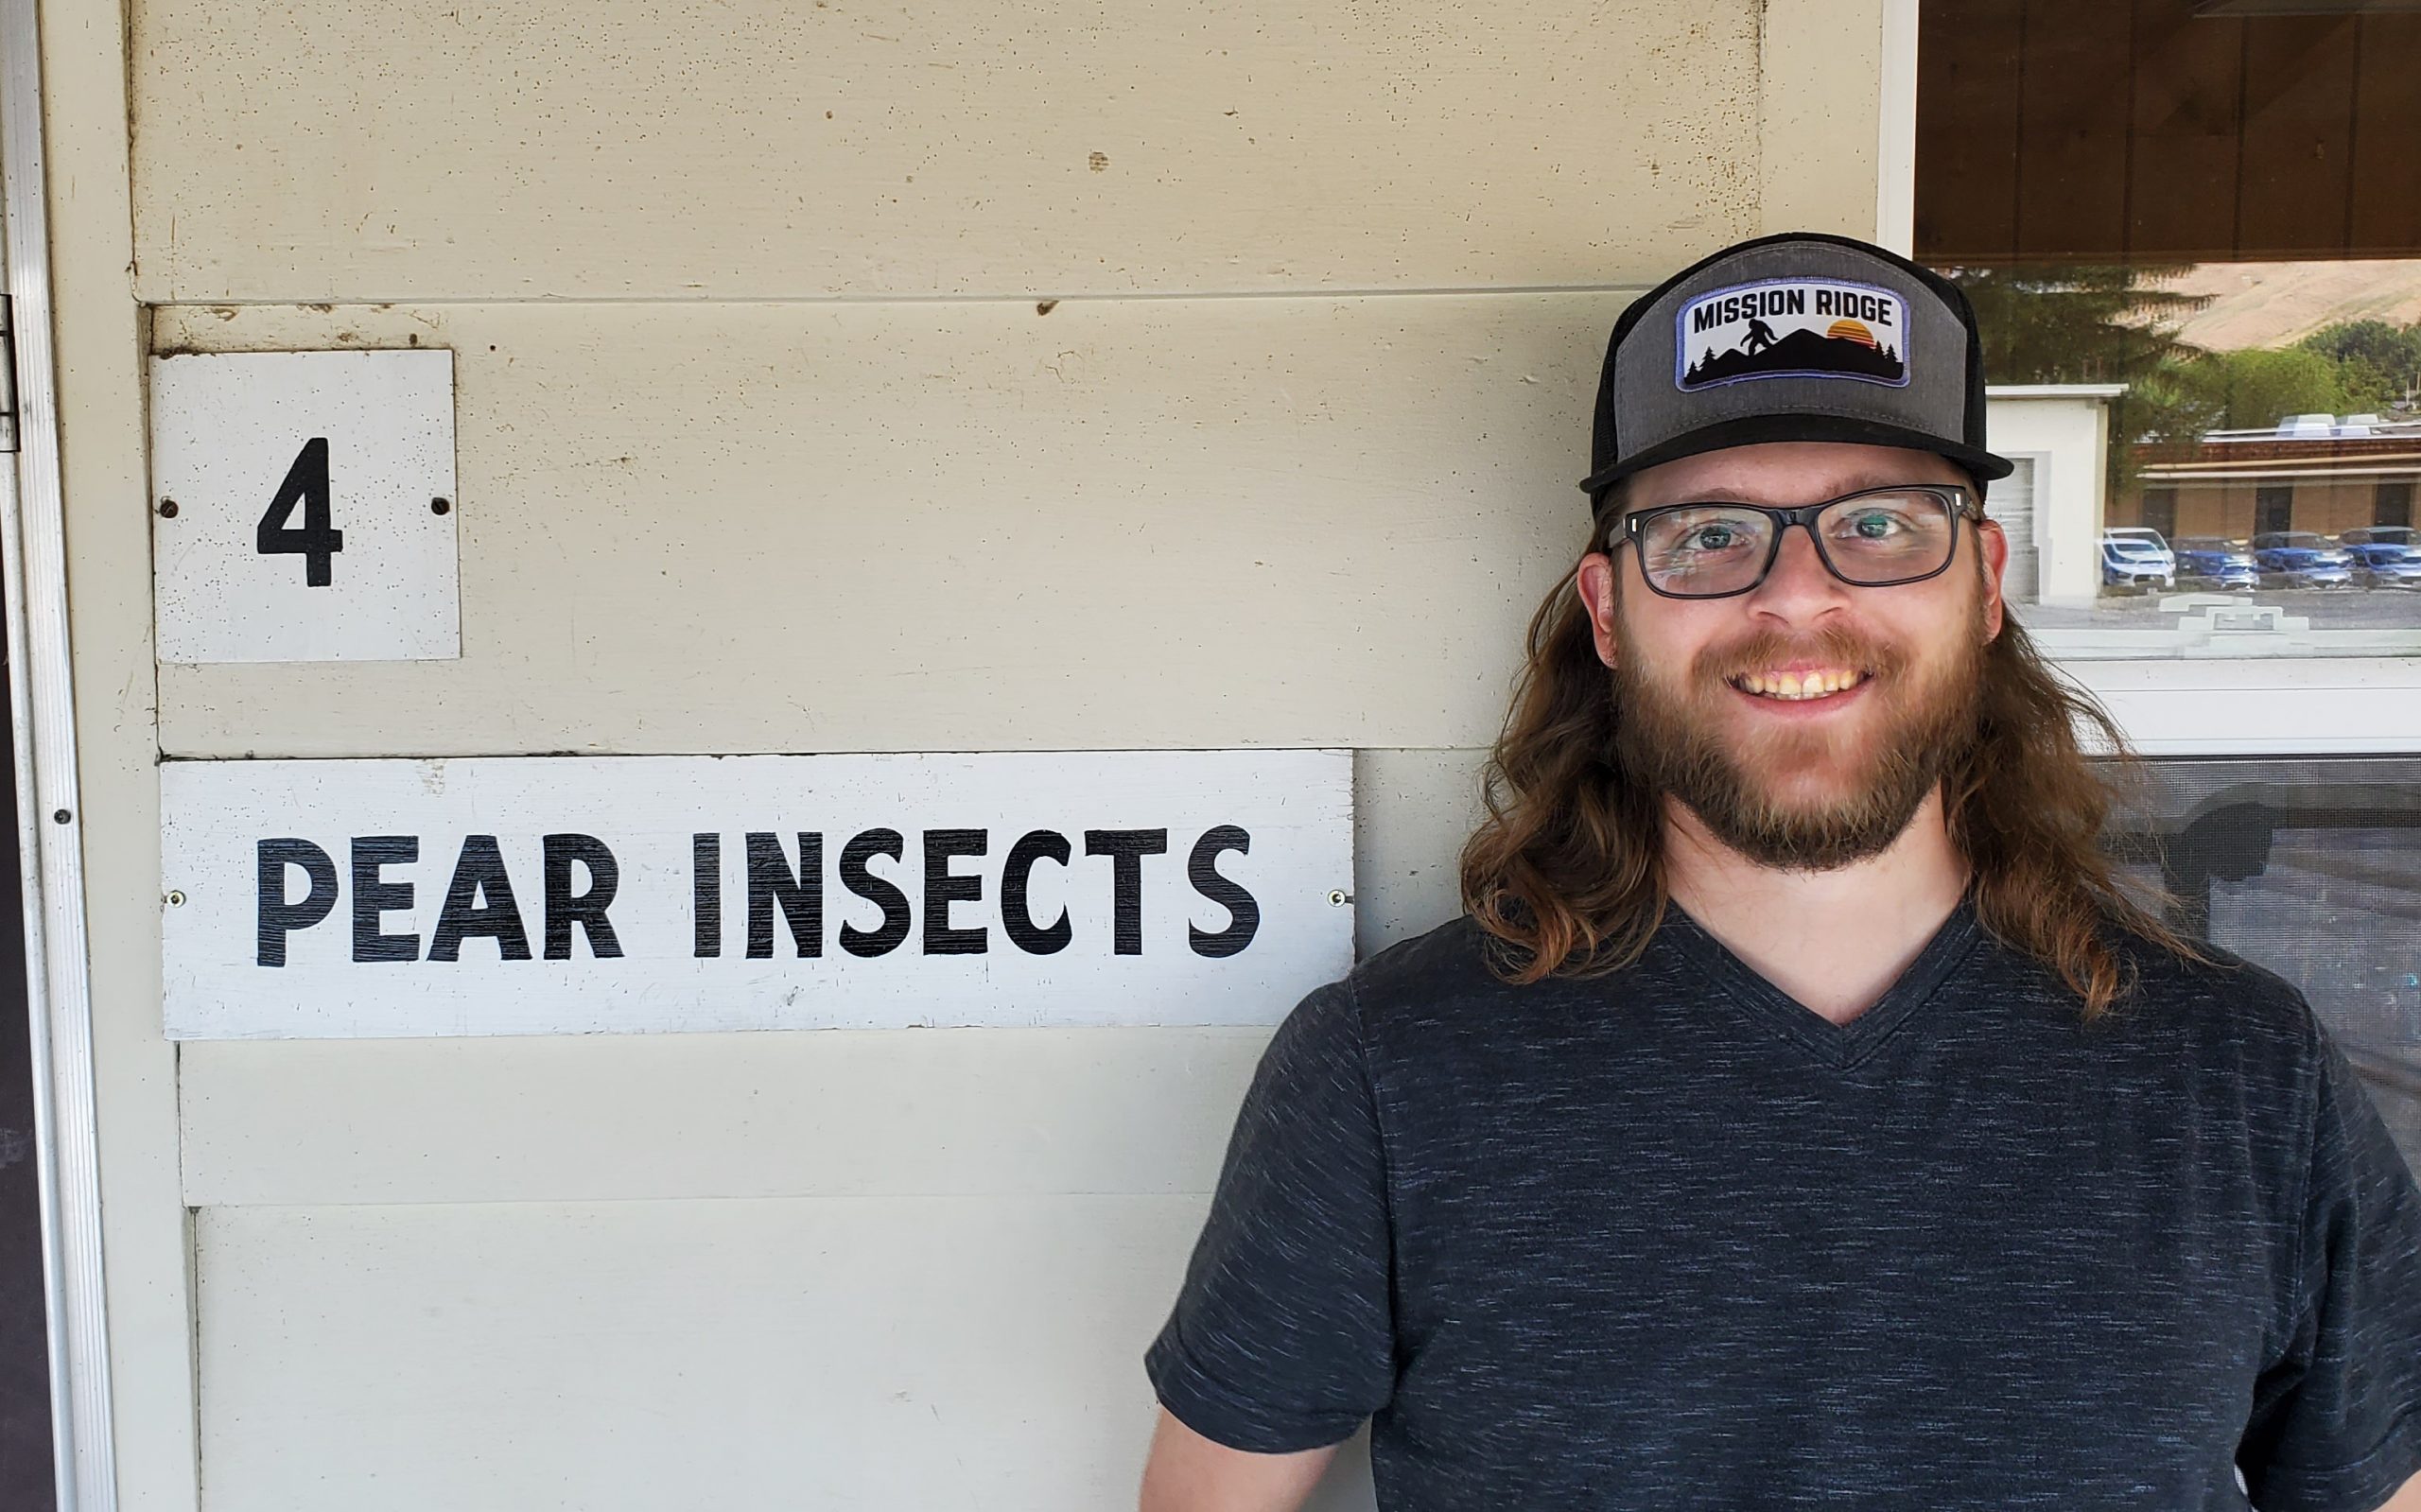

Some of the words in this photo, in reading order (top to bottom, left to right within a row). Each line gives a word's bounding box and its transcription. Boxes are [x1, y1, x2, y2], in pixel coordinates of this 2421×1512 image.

[1694, 289, 1804, 334] MISSION
[1816, 289, 1892, 327] RIDGE
[256, 437, 344, 588] 4
[256, 834, 625, 968] PEAR
[692, 825, 1261, 960] INSECTS
